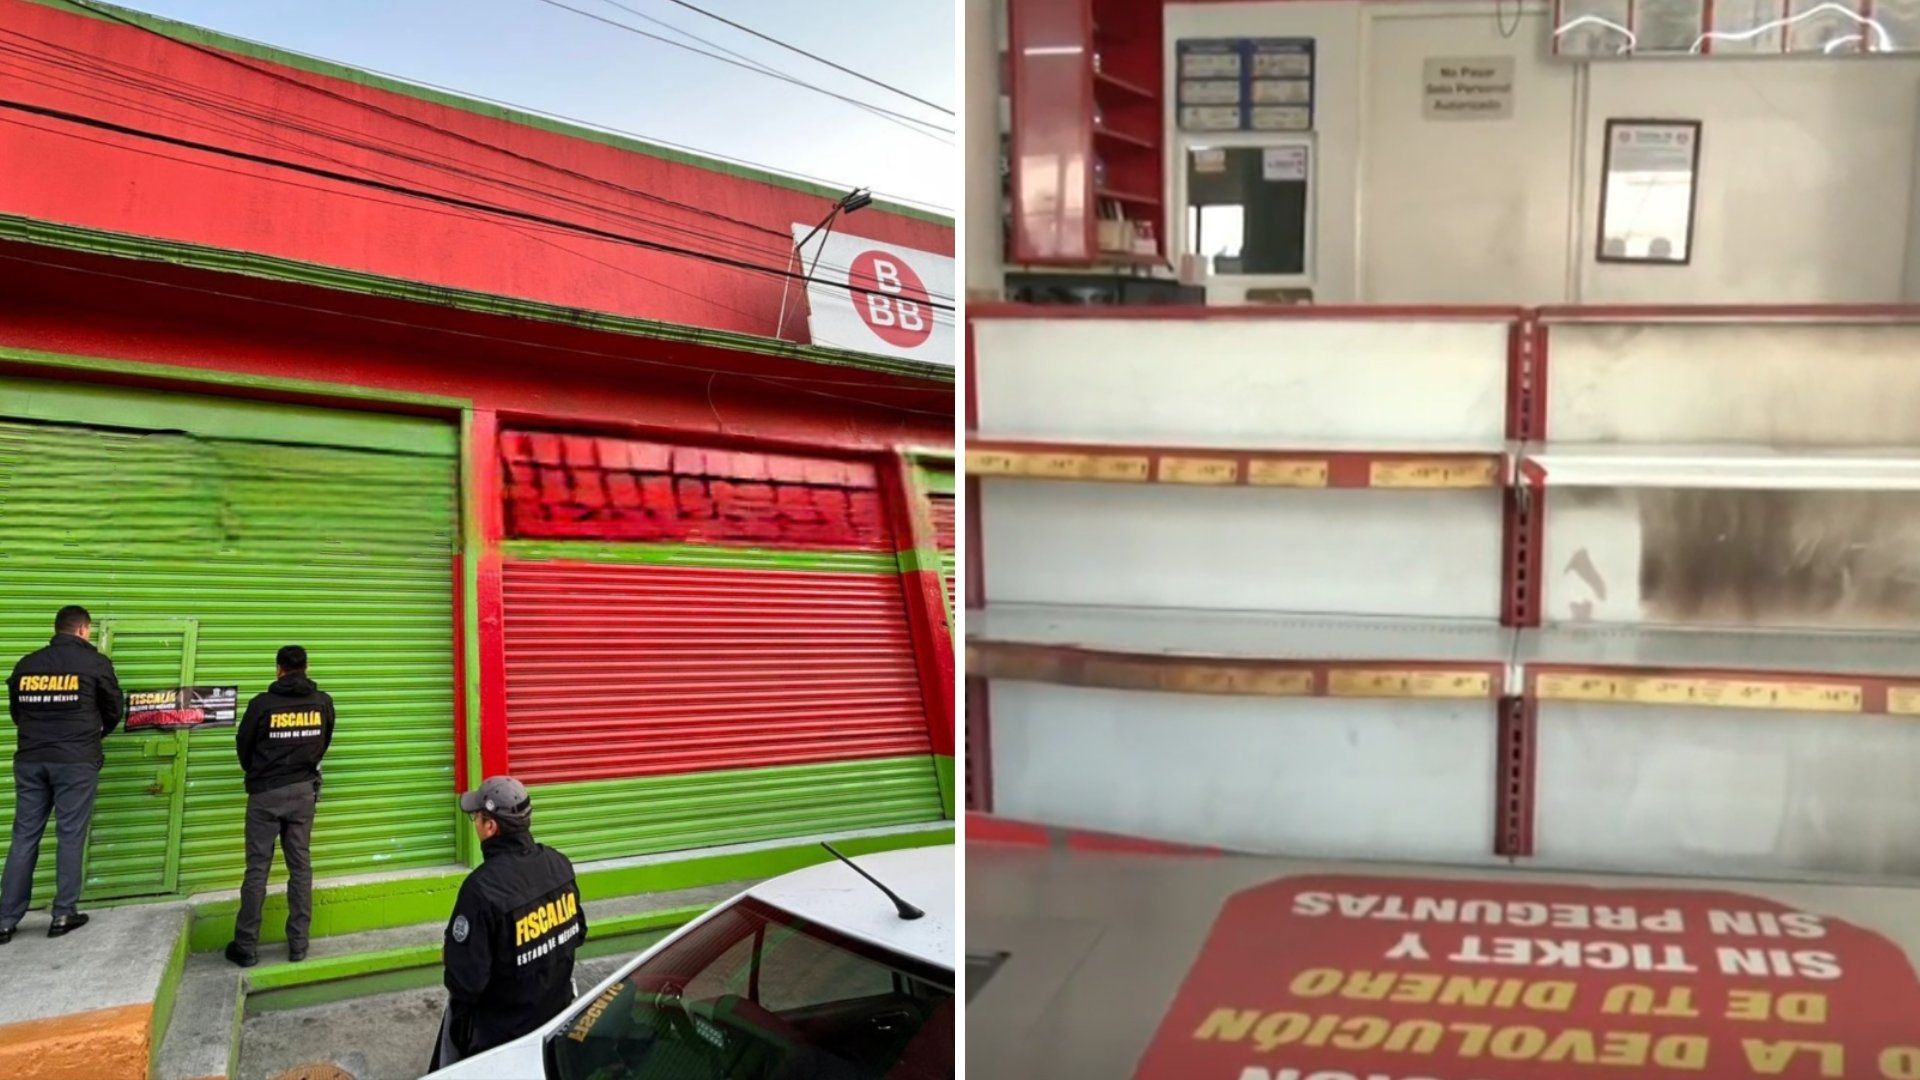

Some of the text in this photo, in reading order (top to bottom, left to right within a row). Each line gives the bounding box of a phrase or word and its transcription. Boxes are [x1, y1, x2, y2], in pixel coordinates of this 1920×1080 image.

[873, 258, 902, 294] B
[866, 291, 924, 331] BB
[19, 674, 79, 691] FISCALÍA
[270, 710, 322, 728] FISCALÍA
[516, 892, 577, 947] FISCALÍA
[1292, 891, 1826, 939] SIN PREGUNTAS
[1384, 931, 1842, 981] SIN TICKET Y
[1289, 968, 1828, 1024] DE TU DINERO
[1195, 1008, 1709, 1070] DEVOLUCIÓN
[1742, 1039, 1844, 1076] LA
